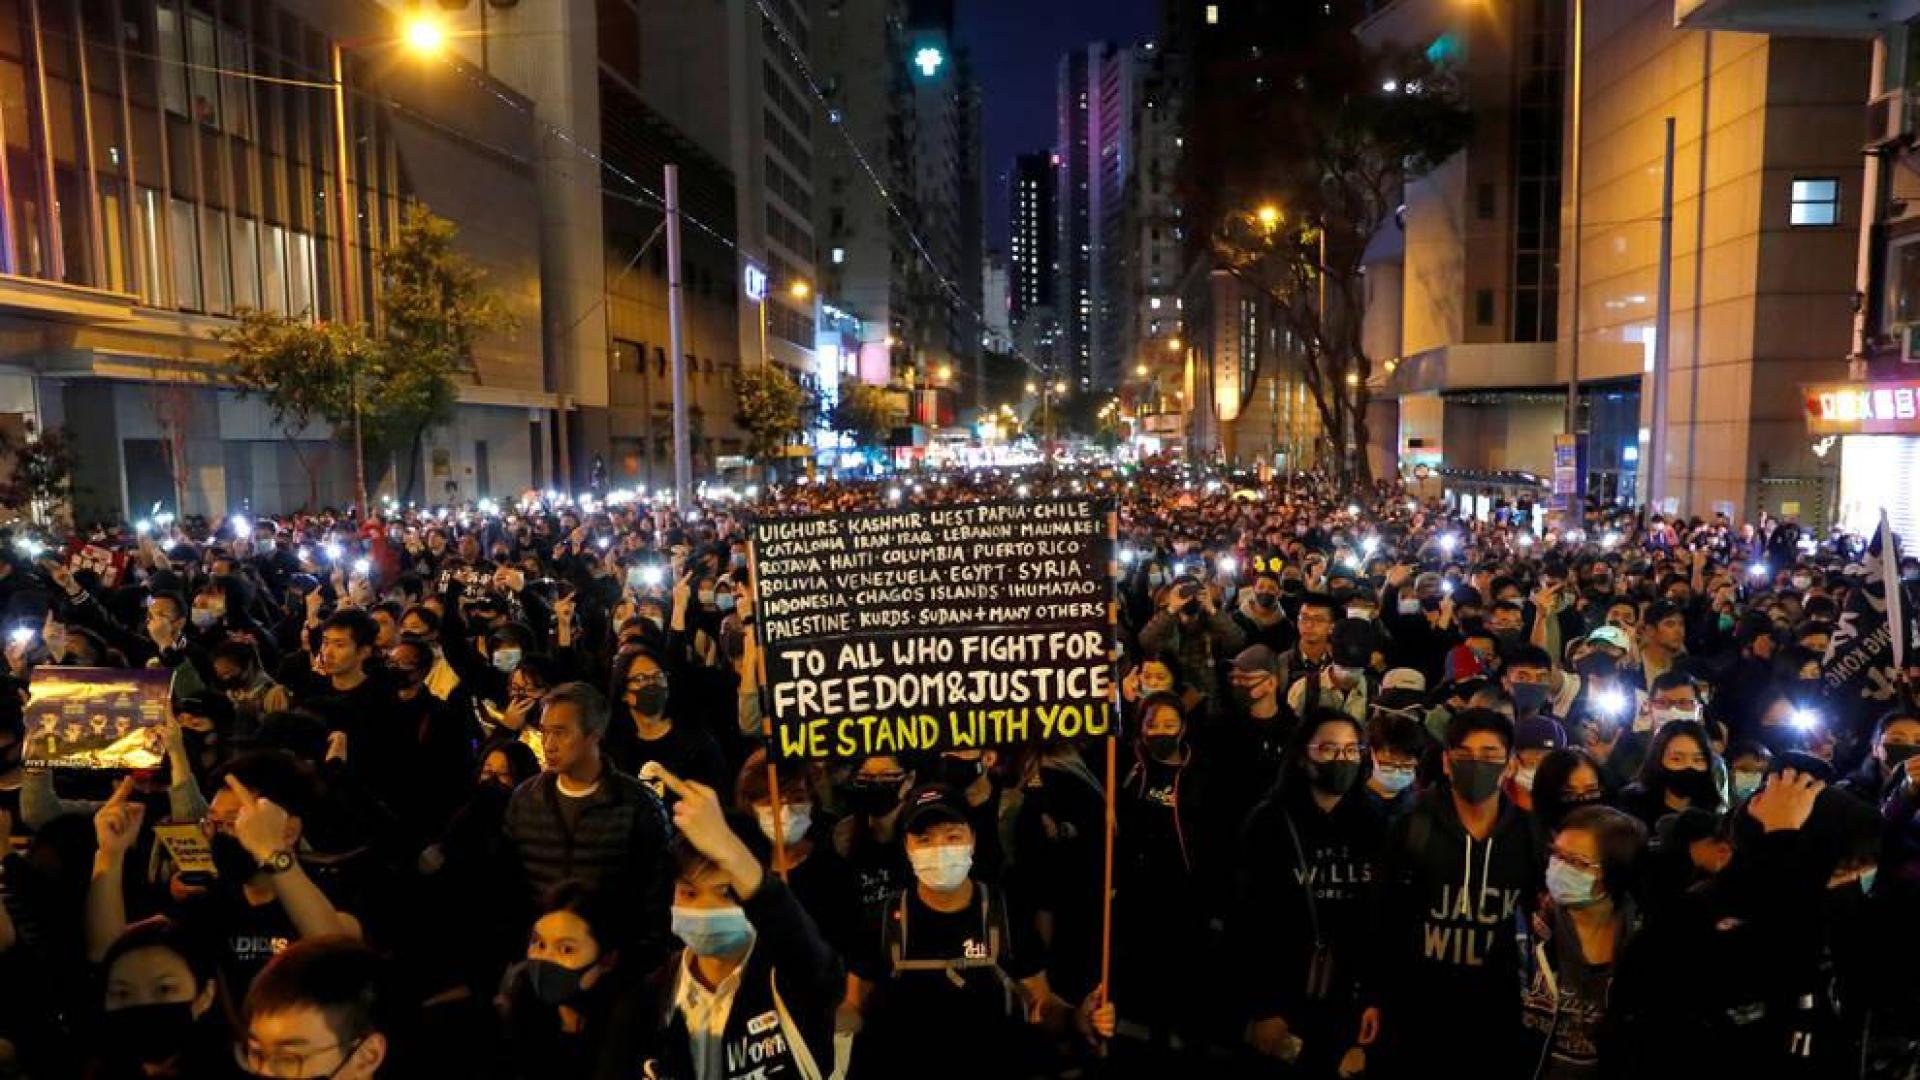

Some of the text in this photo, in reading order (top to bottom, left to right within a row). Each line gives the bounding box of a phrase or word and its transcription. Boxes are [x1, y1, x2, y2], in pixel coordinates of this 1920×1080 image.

[759, 501, 1091, 543] UIGHURS KASHMIR WEST PAPUA CHILE
[765, 536, 846, 558] CATALONIA
[854, 533, 889, 549] IRAN
[897, 530, 933, 546] IRAQ
[943, 523, 1012, 542] LEBANON
[760, 540, 1080, 576] ROJAVA HAITI COLUMBIA PUERTO RICO
[760, 560, 1082, 598] BOLIVIA VENEZUELA EGYPT SYRIA
[764, 592, 850, 618] INDONESIA
[856, 586, 925, 605] CHAGOS
[930, 583, 999, 600] ISLANDS
[765, 611, 851, 641] PALESTINE
[860, 609, 911, 628] KURDS
[1035, 602, 1107, 619] OTHERS
[781, 630, 1106, 678] TO ALL WHO FIGHT FOR
[779, 702, 1110, 758] WE STAND WITH YOU
